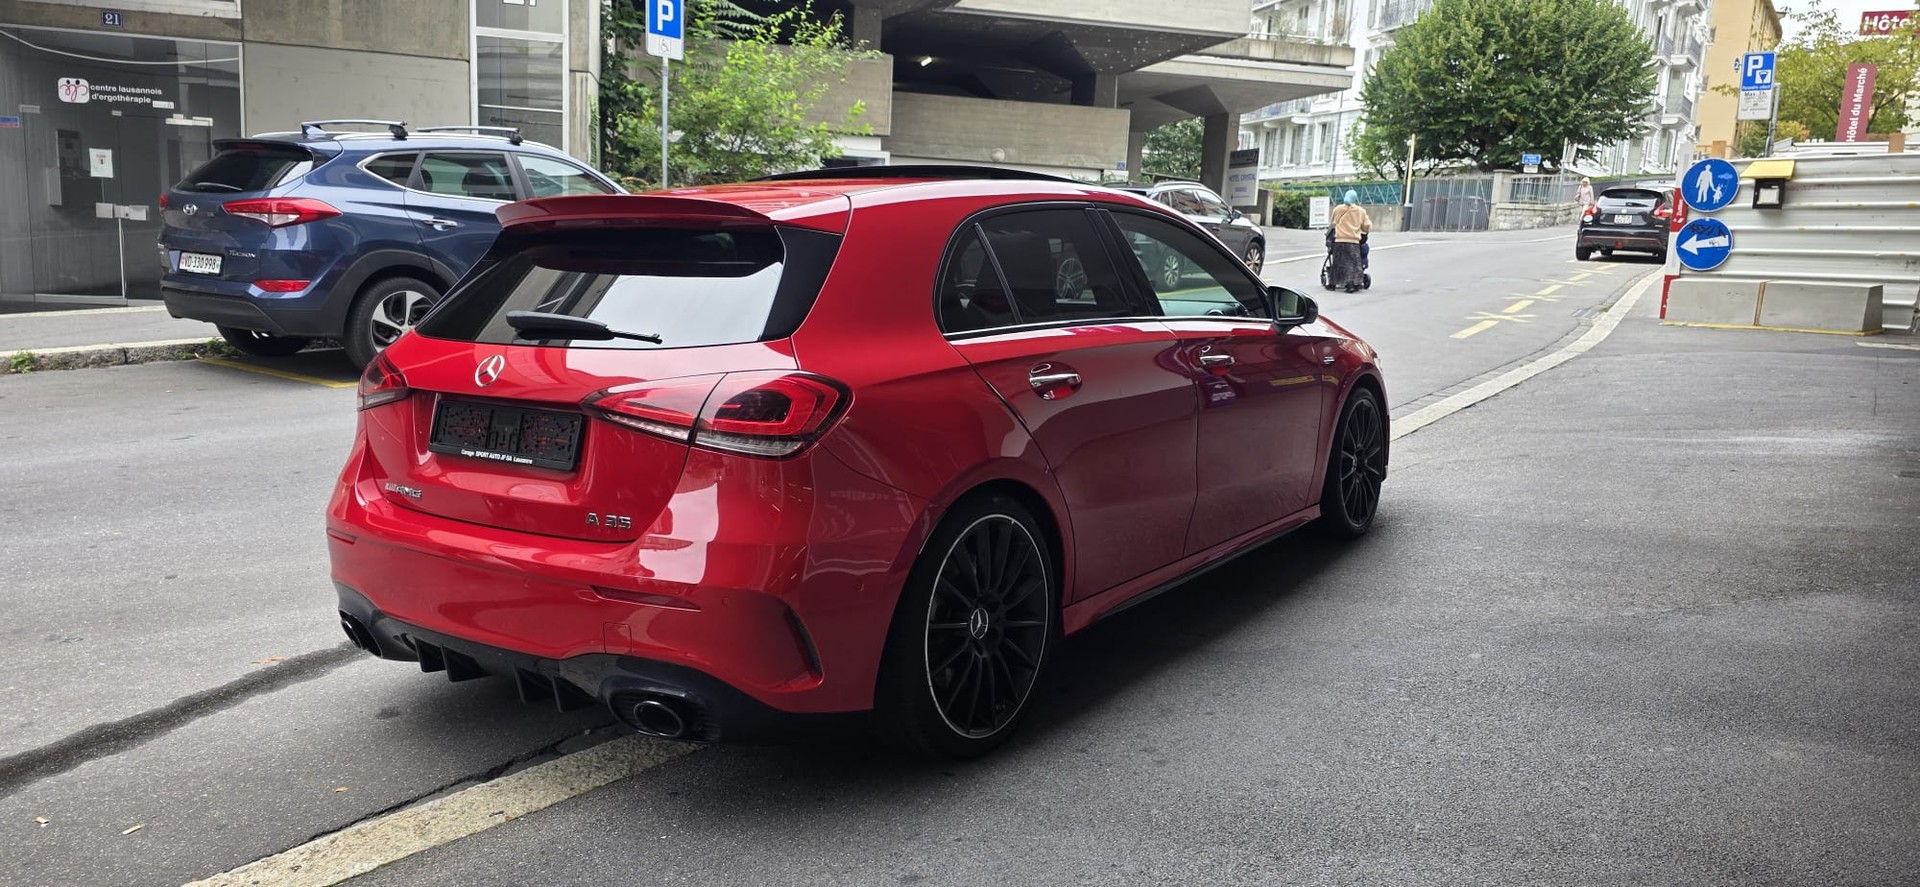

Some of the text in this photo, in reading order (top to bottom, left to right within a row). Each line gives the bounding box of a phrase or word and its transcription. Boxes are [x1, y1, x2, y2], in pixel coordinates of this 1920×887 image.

[105, 13, 120, 25] 21
[657, 0, 674, 31] P
[1747, 55, 1764, 77] P
[90, 84, 162, 95] centre lausannois
[1845, 67, 1868, 142] Hôtel du Marché
[585, 512, 631, 529] A 35
